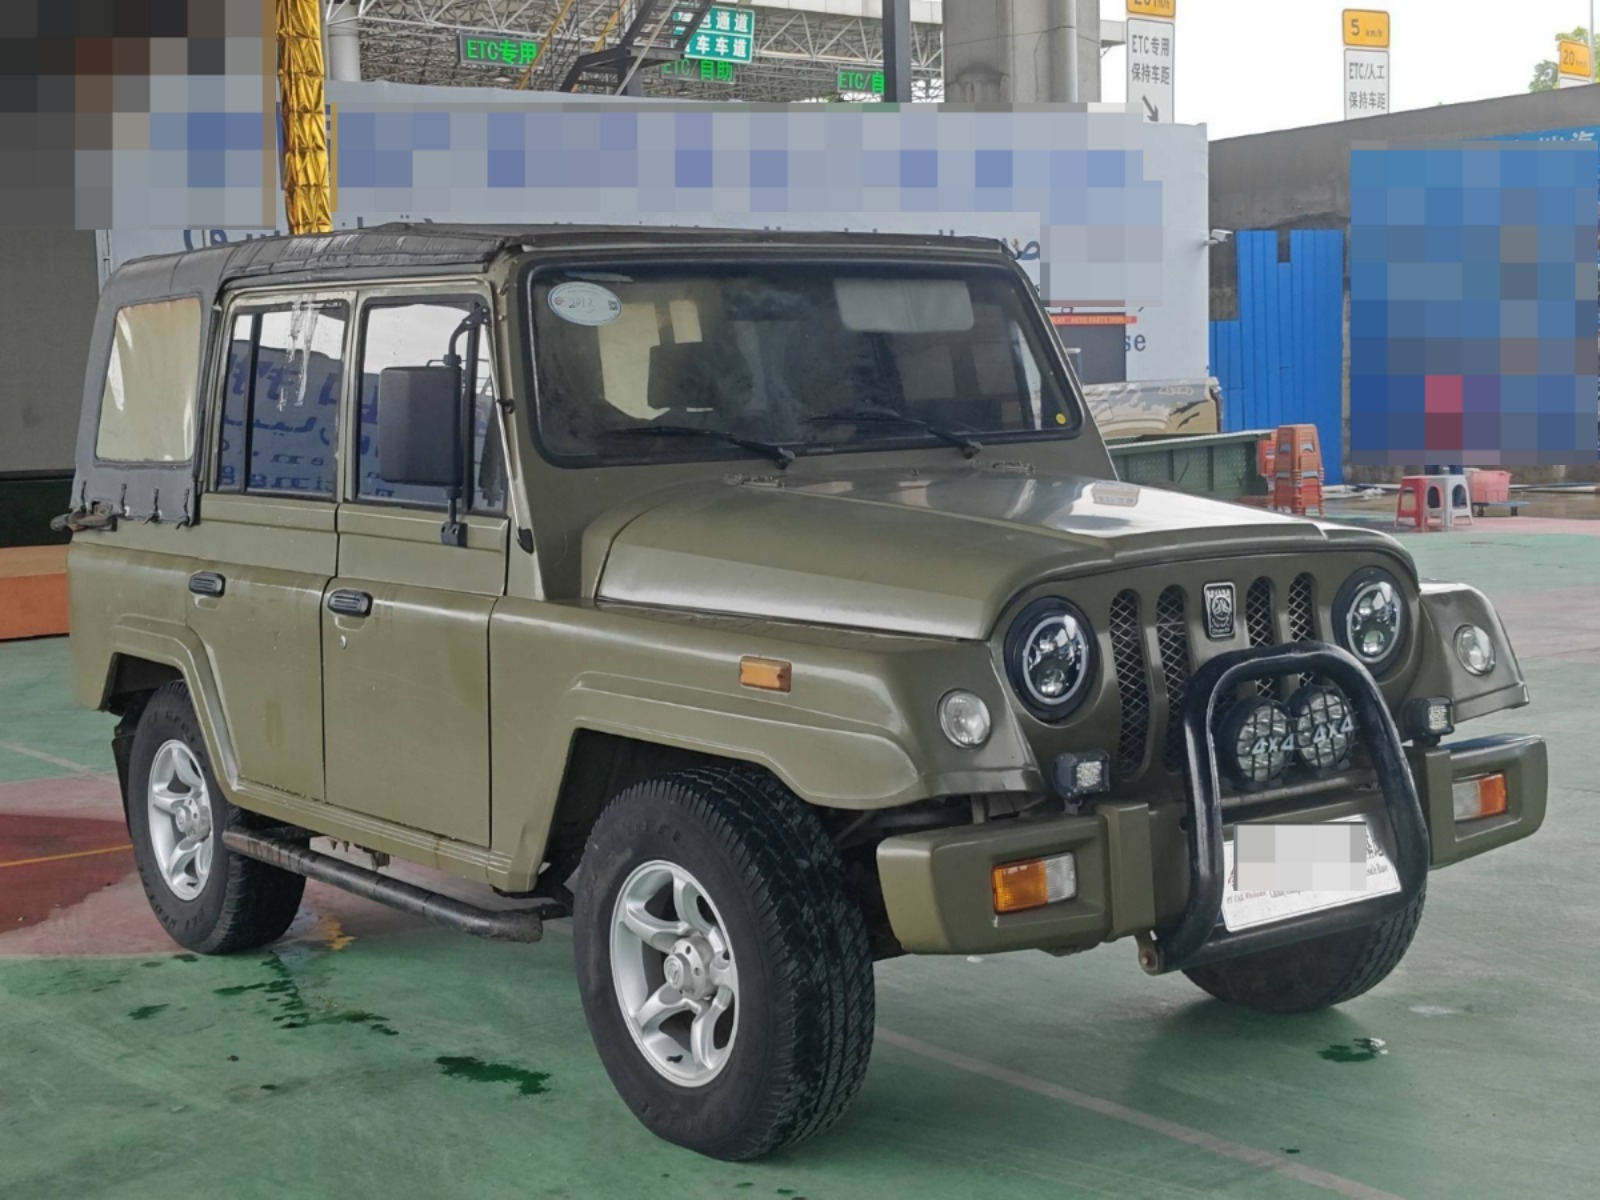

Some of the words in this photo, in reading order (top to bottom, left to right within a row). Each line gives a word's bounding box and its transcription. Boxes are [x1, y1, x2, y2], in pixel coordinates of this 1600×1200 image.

[1351, 18, 1360, 37] 5
[467, 39, 538, 65] ETC专用
[1132, 34, 1170, 57] ETC专用
[1563, 49, 1575, 66] 20
[1349, 62, 1385, 80] ETC/人工
[1349, 91, 1386, 110] 保持车距
